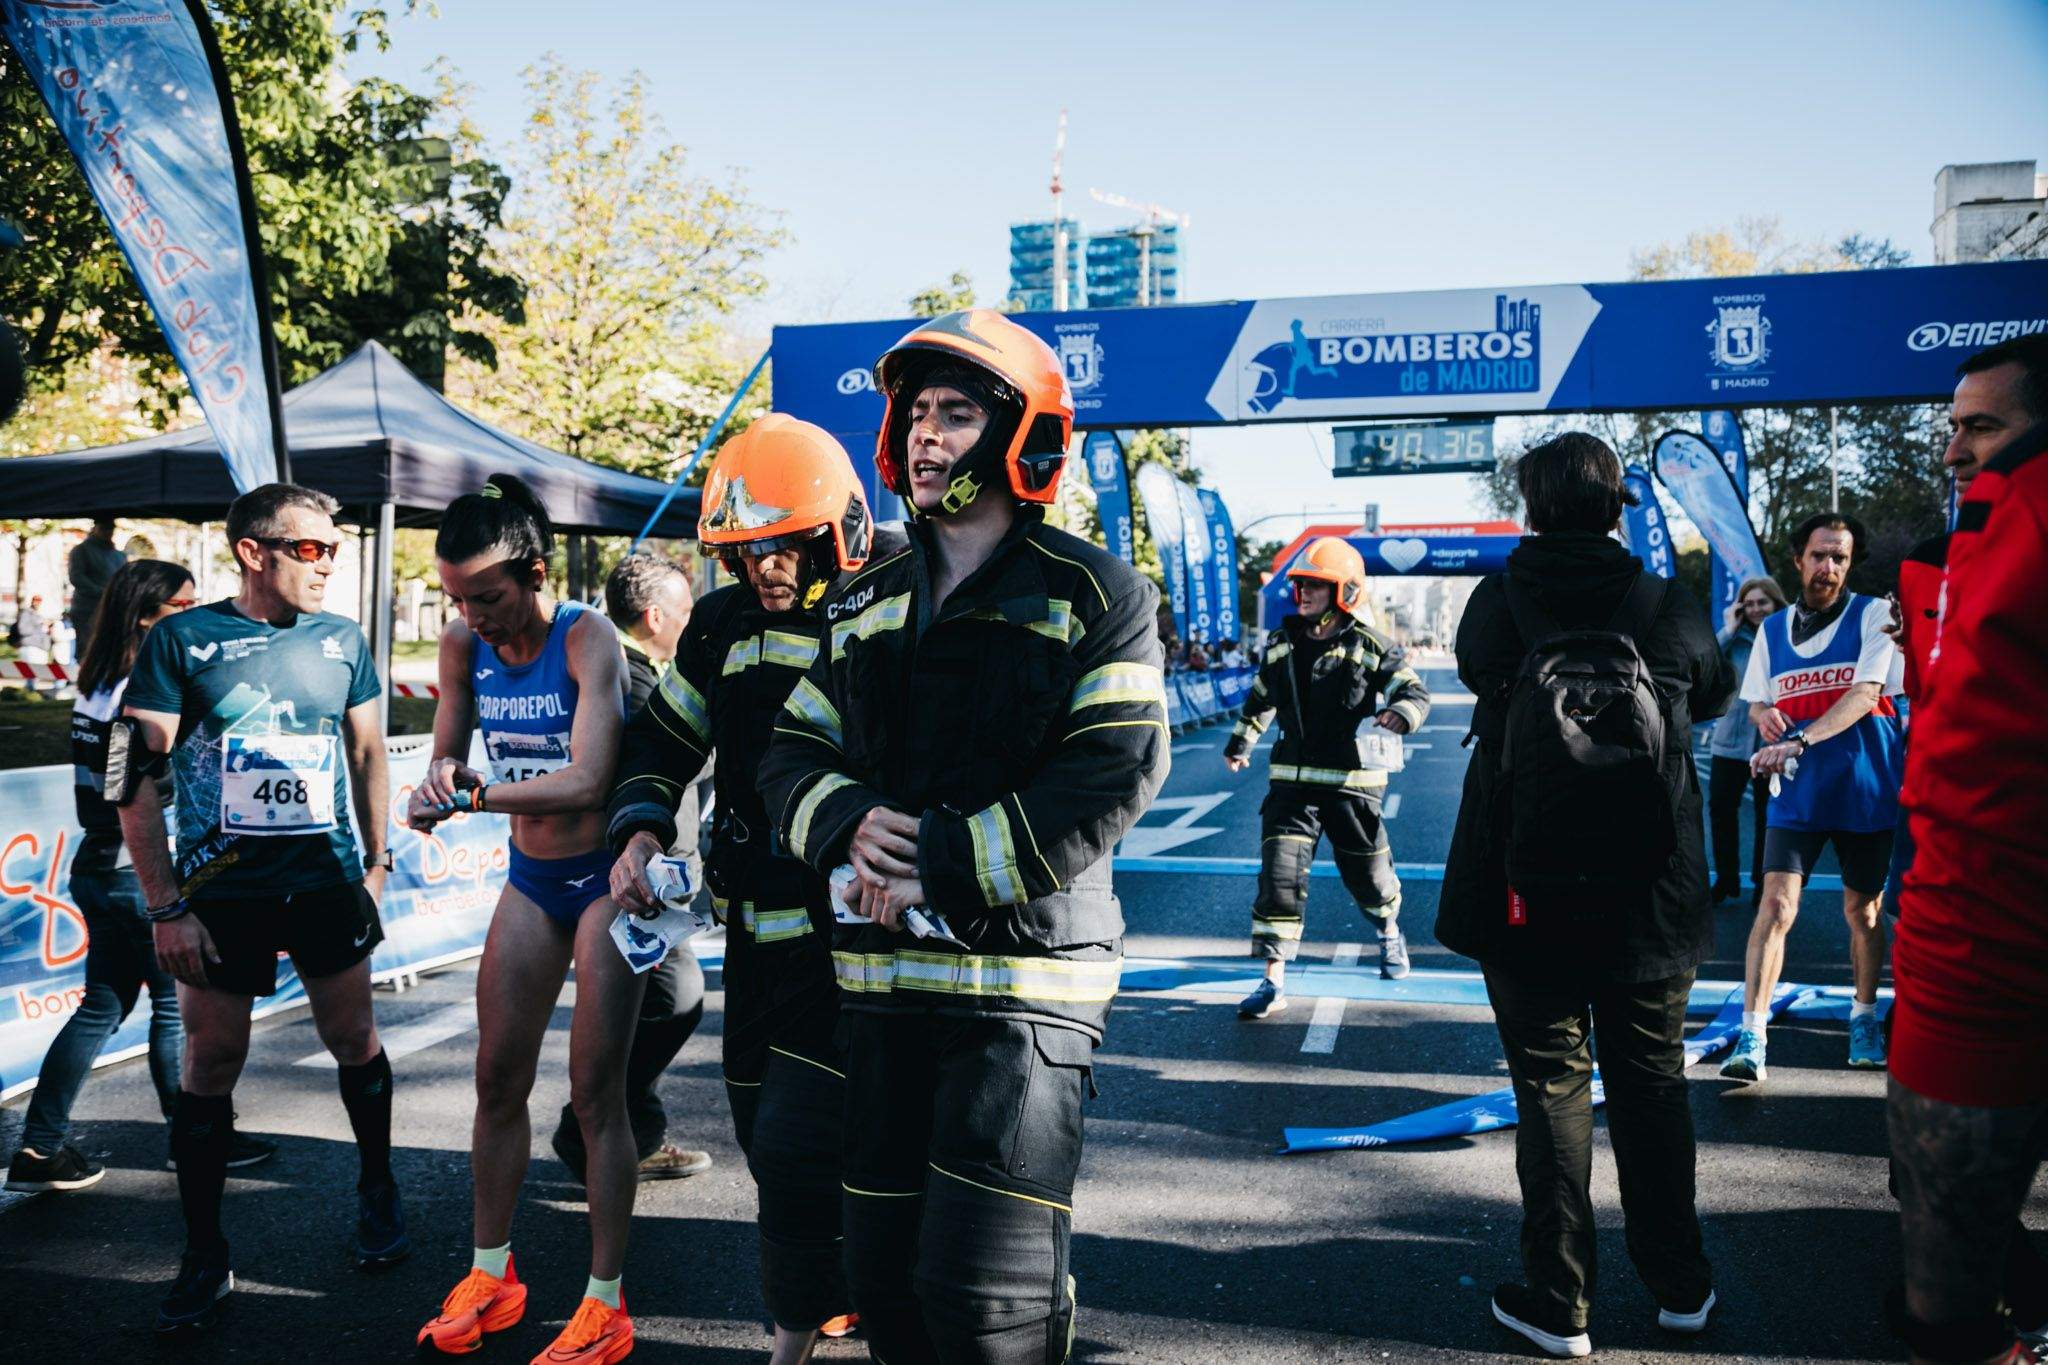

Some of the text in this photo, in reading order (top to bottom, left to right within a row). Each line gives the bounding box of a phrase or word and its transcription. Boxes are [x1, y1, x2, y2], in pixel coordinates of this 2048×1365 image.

[1712, 293, 1766, 305] BOMBEROS
[1054, 322, 1100, 333] BOMBEROS
[1320, 317, 1386, 334] CARRERA
[1948, 319, 2048, 347] ENERVI
[1320, 331, 1534, 366] BOMBEROS
[1400, 360, 1535, 393] de MADRID
[1725, 377, 1770, 389] MADRID
[1073, 399, 1102, 410] ADRID
[827, 585, 874, 620] C-404
[1778, 667, 1855, 692] TOPACIO
[479, 692, 568, 720] CORPOREPOL
[253, 779, 308, 805] 468
